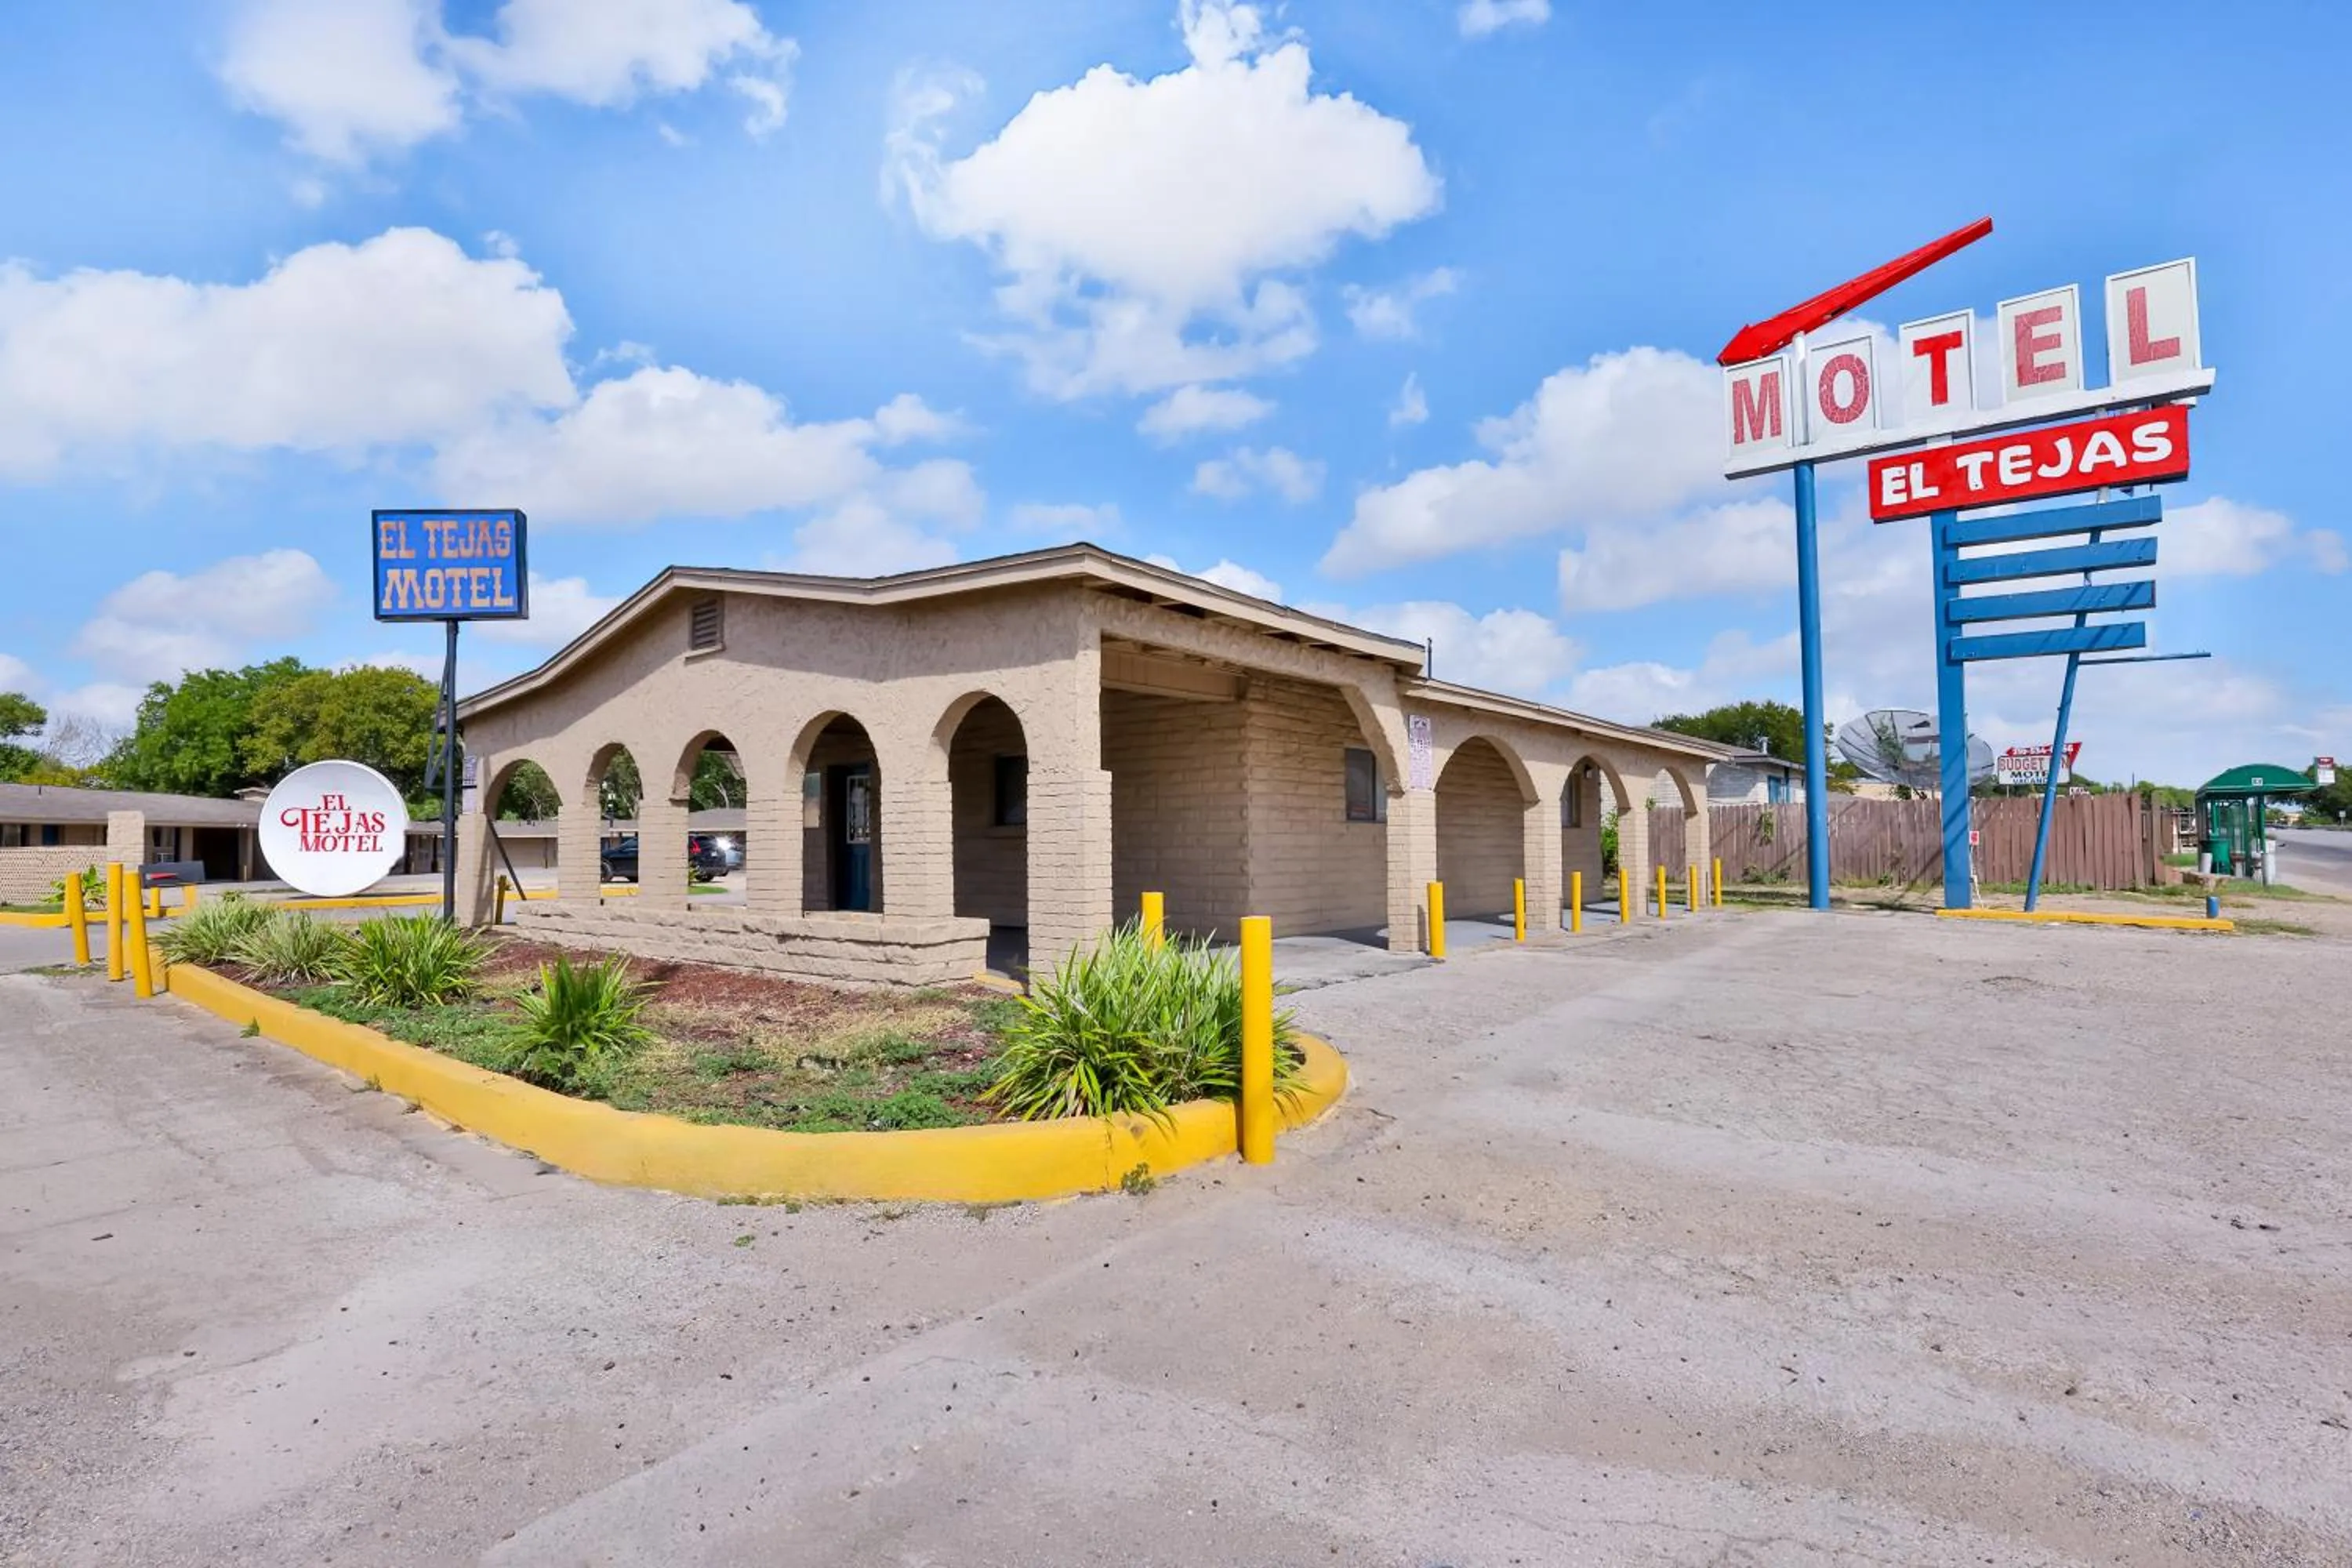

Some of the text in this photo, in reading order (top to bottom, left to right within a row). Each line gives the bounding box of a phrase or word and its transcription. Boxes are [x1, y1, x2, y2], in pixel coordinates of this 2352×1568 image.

[1732, 285, 2181, 445] MOTEL
[1882, 420, 2172, 506] EL TEJAS
[379, 520, 511, 559] EL TEJAS
[382, 567, 514, 609] MOTEL
[1998, 757, 2045, 771] BUDGET
[321, 794, 352, 811] EL
[280, 807, 386, 834] TEJAS
[299, 833, 383, 852] MOTEL
